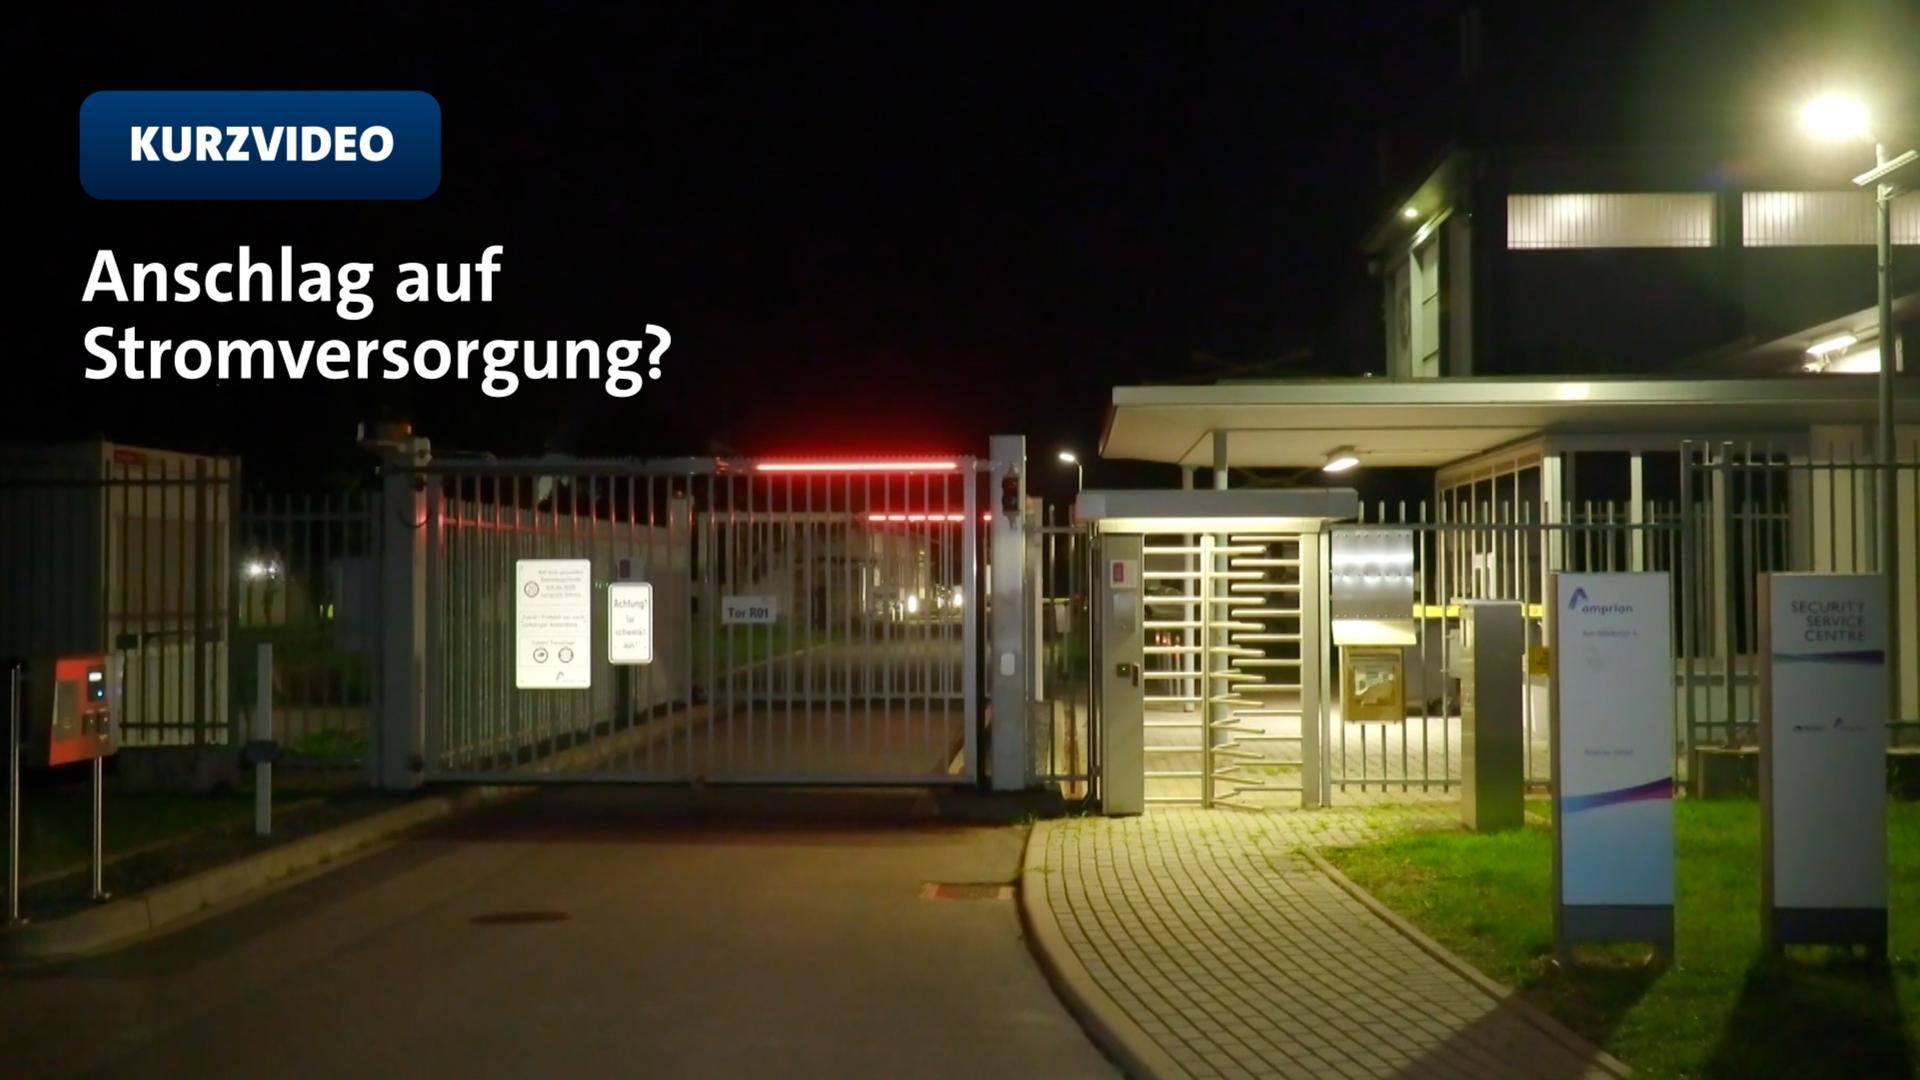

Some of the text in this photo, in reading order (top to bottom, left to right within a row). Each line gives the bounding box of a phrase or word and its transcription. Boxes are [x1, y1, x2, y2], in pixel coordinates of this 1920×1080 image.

[728, 607, 769, 618] Tor R01
[1581, 604, 1634, 615] amprion
[1791, 600, 1865, 614] SECURITY
[1805, 615, 1865, 628] SERVICE
[1804, 630, 1865, 642] CENTRE
